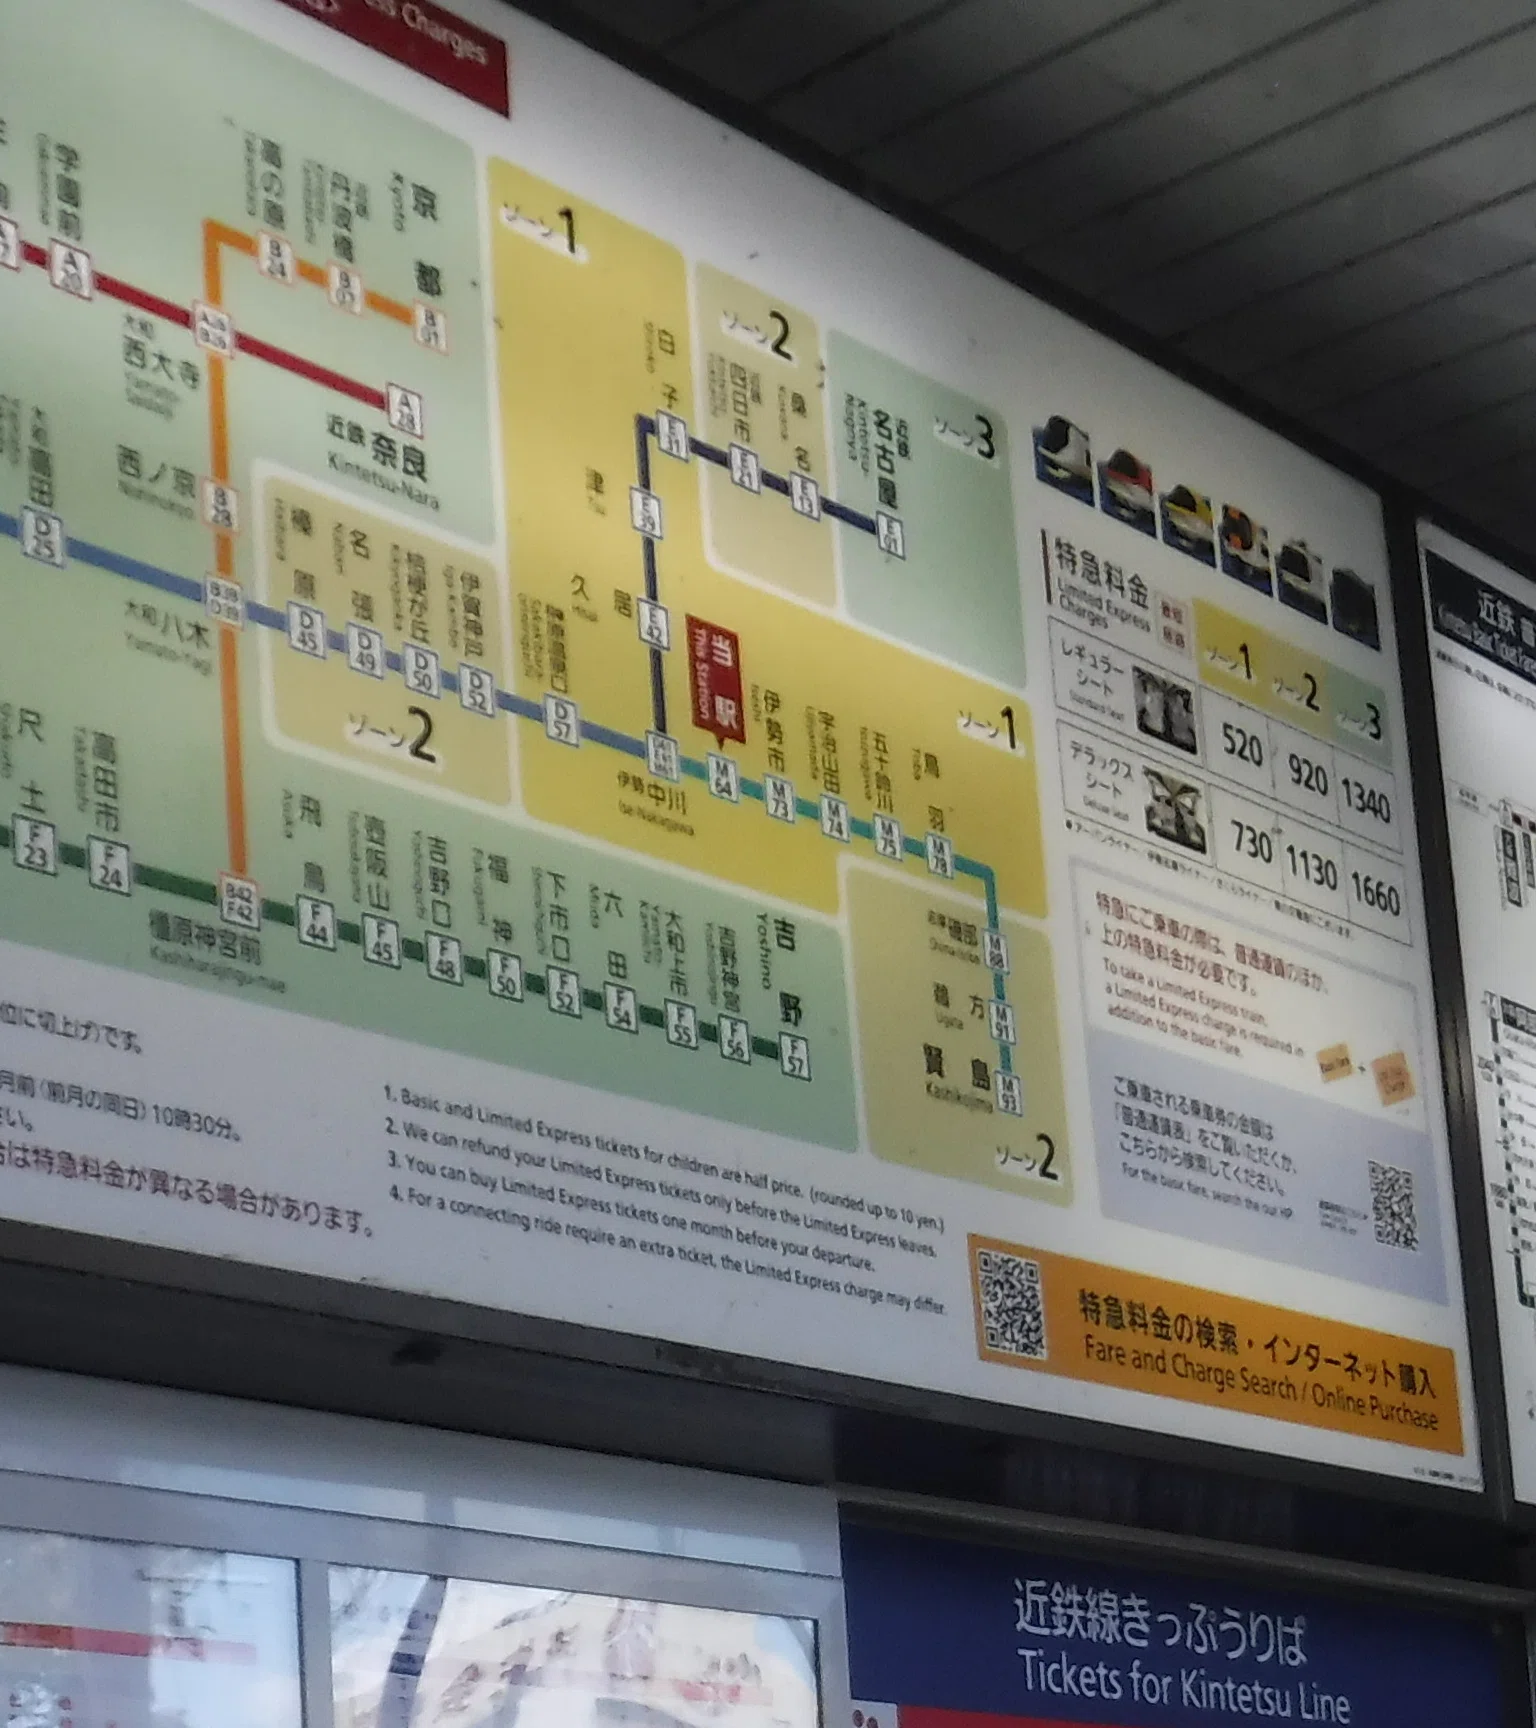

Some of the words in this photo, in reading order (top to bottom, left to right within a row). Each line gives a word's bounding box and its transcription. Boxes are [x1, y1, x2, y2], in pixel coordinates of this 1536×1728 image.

[1054, 535, 1150, 610] 特急料金
[1222, 721, 1264, 768] 520
[1287, 752, 1329, 797] 920
[771, 797, 790, 820] 73
[1341, 777, 1391, 824] 1340
[827, 816, 845, 838] 74
[880, 836, 898, 858] 75
[1230, 818, 1273, 864] 730
[23, 845, 47, 869] 23
[1286, 843, 1338, 892] 1130
[99, 865, 123, 890] 24
[1351, 869, 1401, 917] 1660
[306, 922, 328, 943] 44
[371, 940, 393, 961] 45
[434, 959, 455, 980] 48
[496, 973, 516, 995] 50
[555, 991, 574, 1011] 52
[613, 1005, 633, 1028] 54
[673, 1025, 692, 1044] 55
[727, 1040, 745, 1060] 56
[787, 1056, 804, 1075] 57
[1083, 1332, 1126, 1368] Fare
[1130, 1349, 1167, 1375] and
[1170, 1351, 1238, 1394] Charge
[1239, 1365, 1298, 1403] Search
[1311, 1382, 1367, 1419] Online
[1369, 1393, 1440, 1433] Purchase
[1013, 1576, 1309, 1669] 近鉄線きっぷうりば
[1016, 1647, 1125, 1701] Tickets
[1127, 1658, 1174, 1707] for
[1179, 1667, 1294, 1719] Kintetsu
[1298, 1681, 1354, 1726] Line
